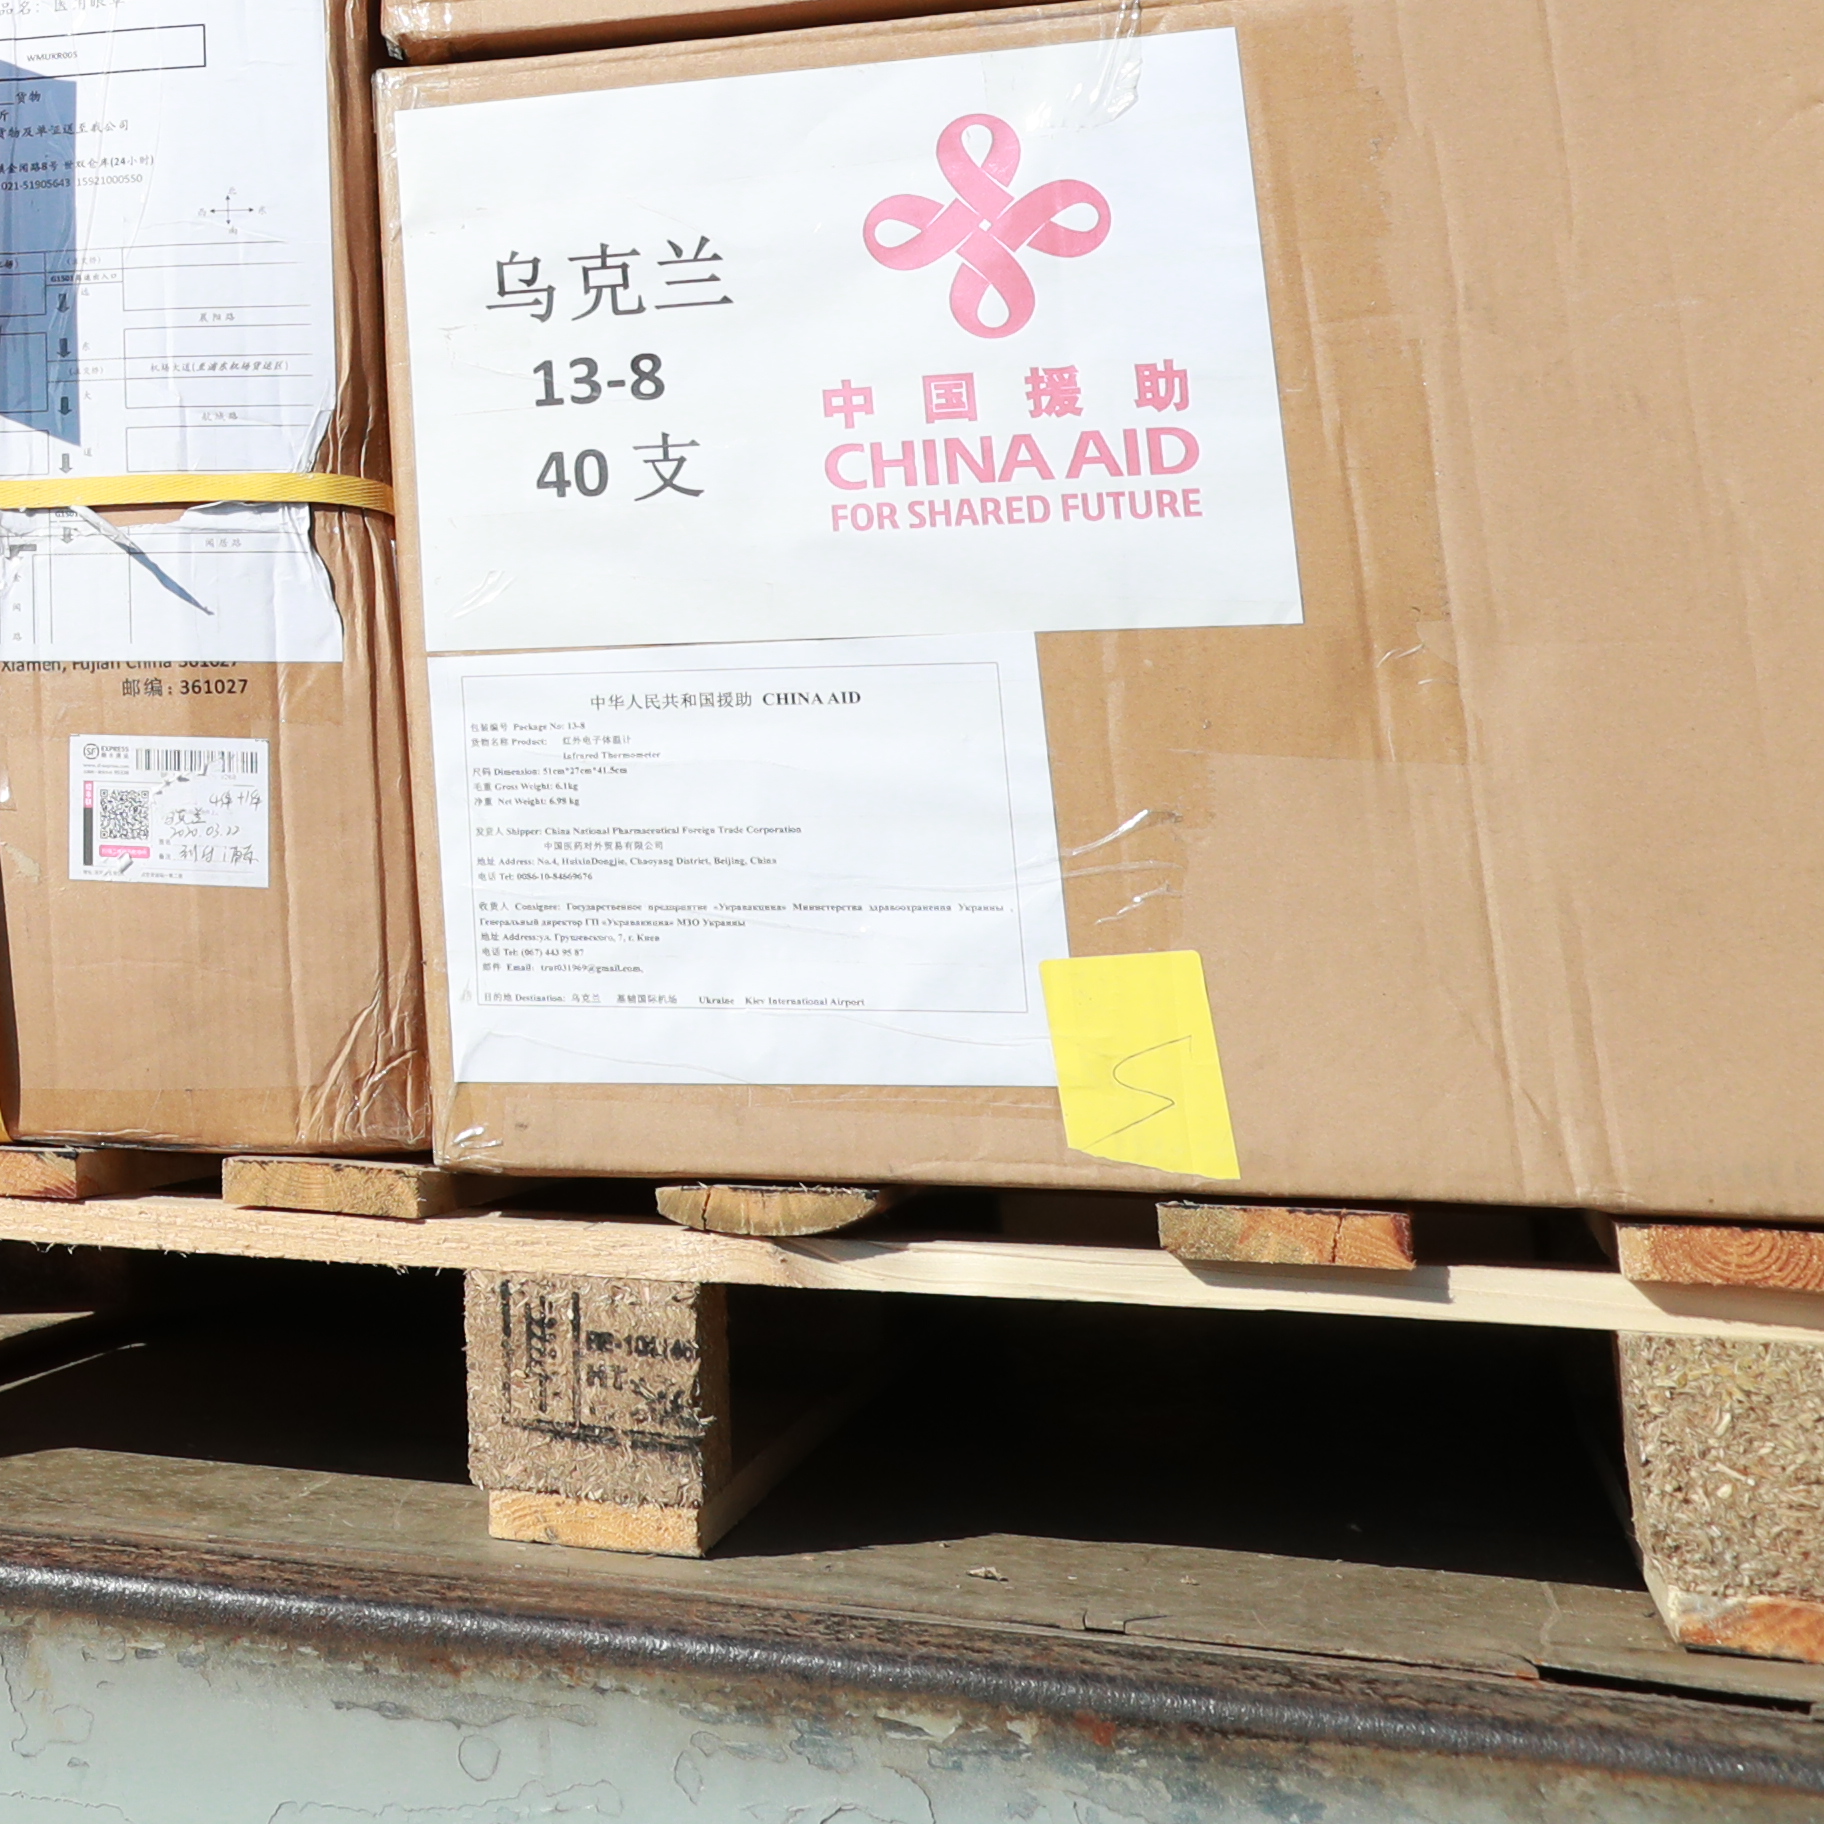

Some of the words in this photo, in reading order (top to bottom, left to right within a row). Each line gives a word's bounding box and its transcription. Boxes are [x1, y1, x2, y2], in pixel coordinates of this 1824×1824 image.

[485, 235, 734, 323] 乌克兰
[531, 352, 666, 409] 13-8
[821, 357, 1193, 430] 中国援助
[536, 451, 609, 498] 40
[632, 431, 705, 502] 支
[824, 430, 1056, 490] CHINA
[1064, 426, 1200, 479] AID
[830, 501, 899, 532] FOR
[908, 493, 1051, 529] SHARED
[1060, 487, 1203, 524] FUTURE
[589, 690, 753, 712] 中华人民共和国援助
[761, 690, 825, 706] CHINA
[826, 689, 862, 705] AID
[512, 722, 547, 732] Package
[562, 734, 632, 746] 红外电子体温计
[562, 751, 599, 760] Infrared
[601, 750, 661, 759] Thermometer
[494, 782, 519, 791] Gross
[520, 781, 553, 792] Weight:
[544, 826, 570, 835] China
[572, 826, 609, 835] National
[612, 825, 680, 835] Pharmaceutical
[681, 825, 715, 837] Foreign
[717, 825, 744, 834] Trade
[746, 824, 802, 836] Corporation
[629, 856, 673, 867] Chaoyang
[749, 856, 777, 866] China
[698, 995, 735, 1005] Ukraine
[744, 996, 766, 1004] Kiev
[767, 996, 828, 1005] International
